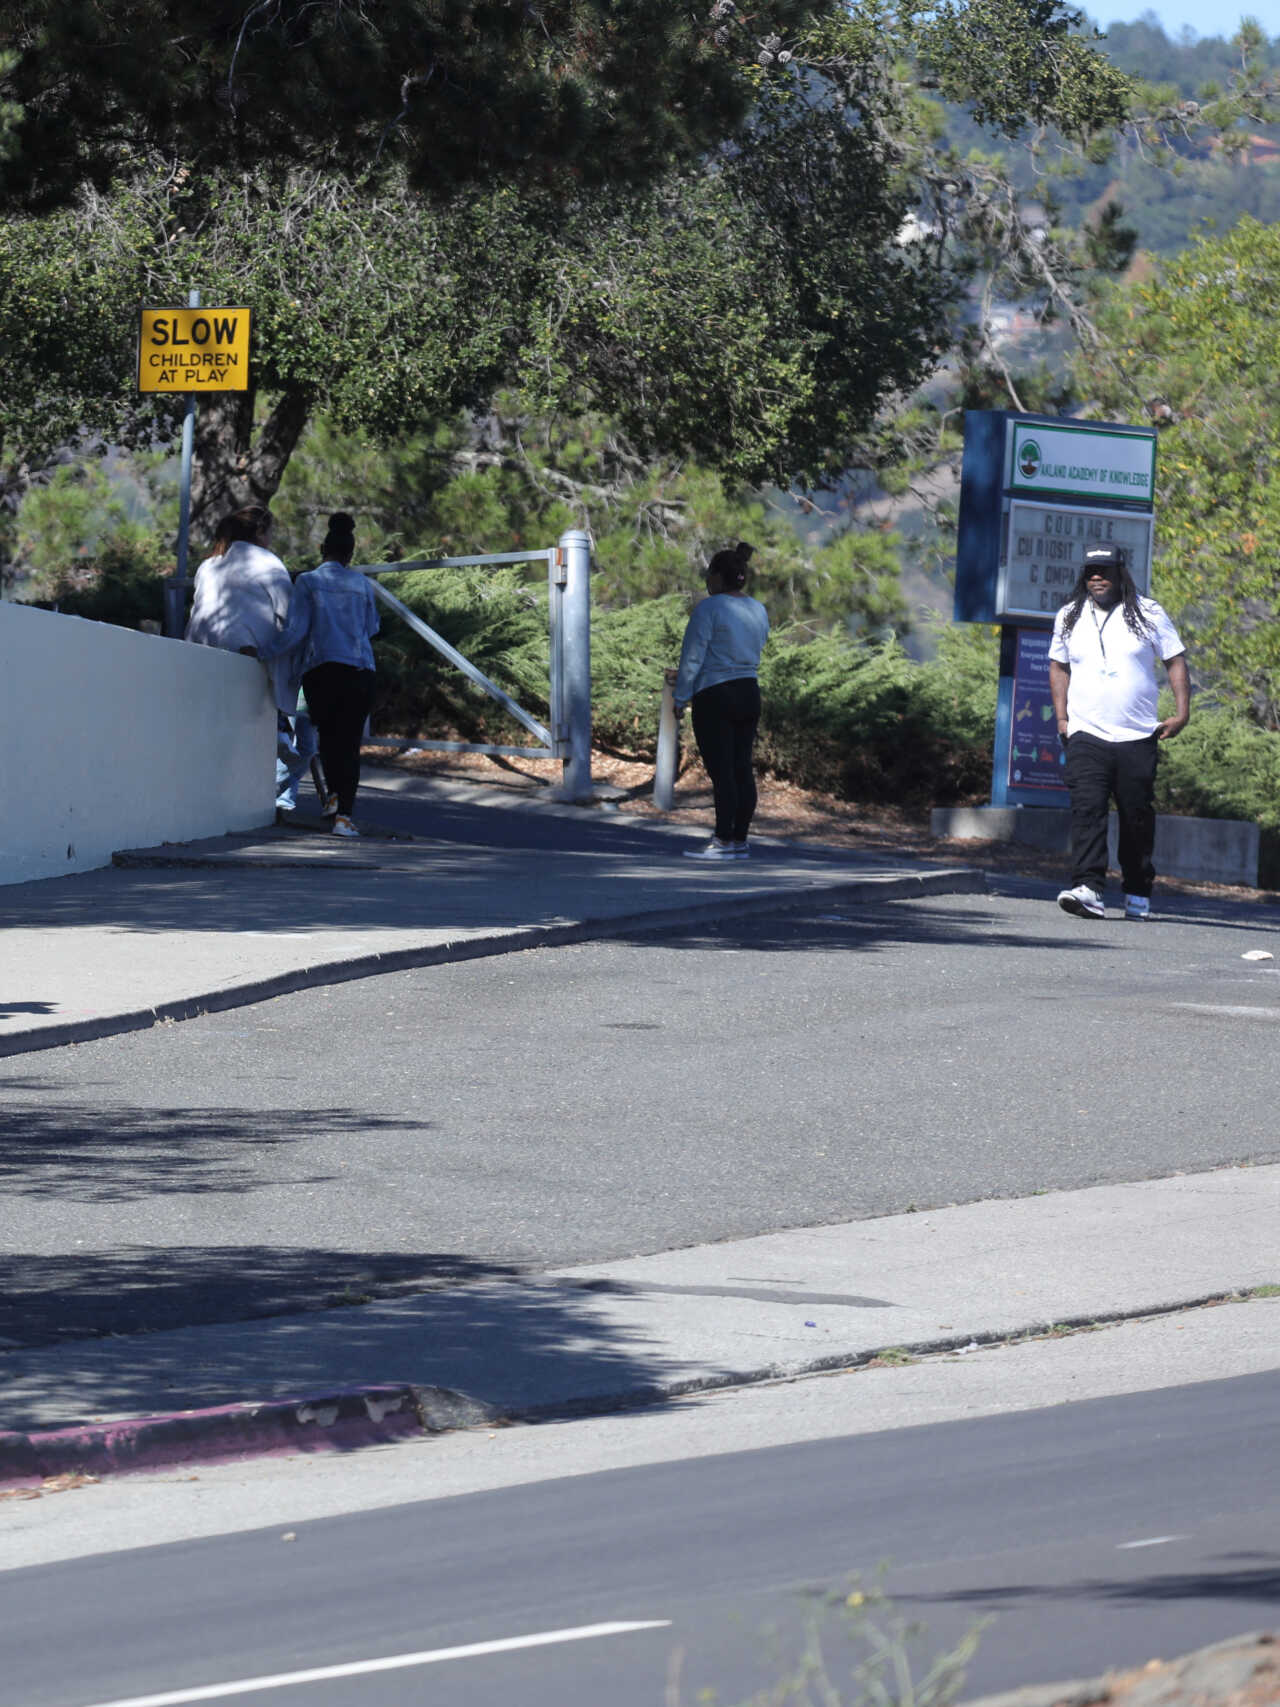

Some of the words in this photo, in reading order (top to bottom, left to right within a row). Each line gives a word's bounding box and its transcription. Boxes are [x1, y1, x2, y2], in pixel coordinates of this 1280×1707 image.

[150, 317, 238, 346] SLOW
[149, 352, 239, 367] CHILDREN
[157, 370, 179, 384] AT
[185, 369, 229, 383] PLAY
